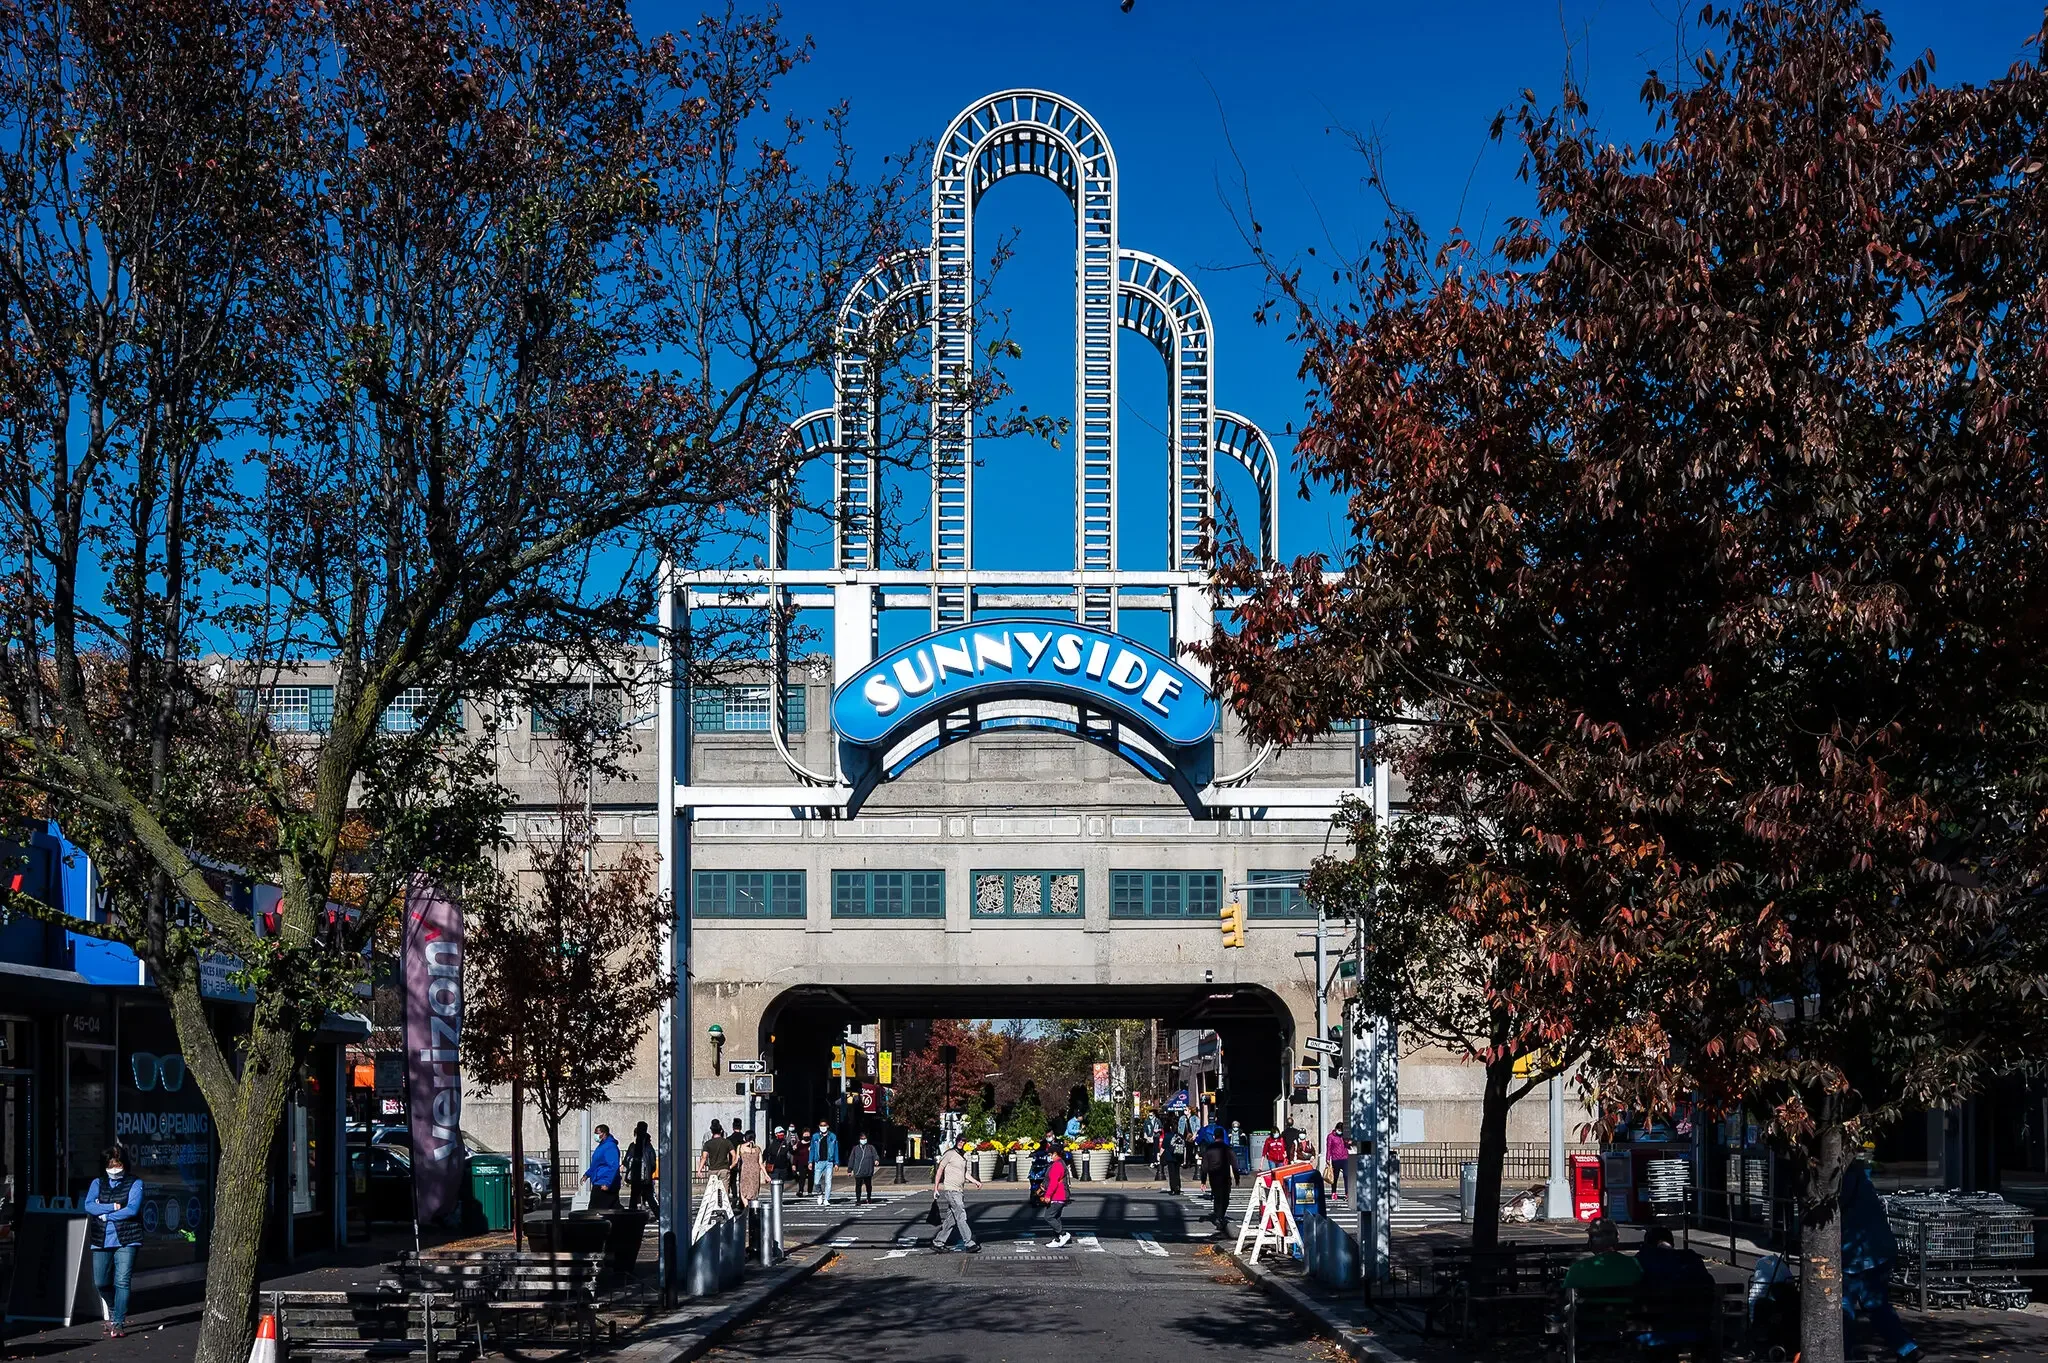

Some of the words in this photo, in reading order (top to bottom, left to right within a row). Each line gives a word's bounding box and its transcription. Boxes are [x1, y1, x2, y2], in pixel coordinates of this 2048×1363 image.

[864, 629, 1185, 719] SUNNYSIDE
[73, 1015, 100, 1032] 45-04
[420, 941, 461, 1161] verizon
[116, 1111, 158, 1135] GRAND
[159, 1111, 208, 1134] OPENING
